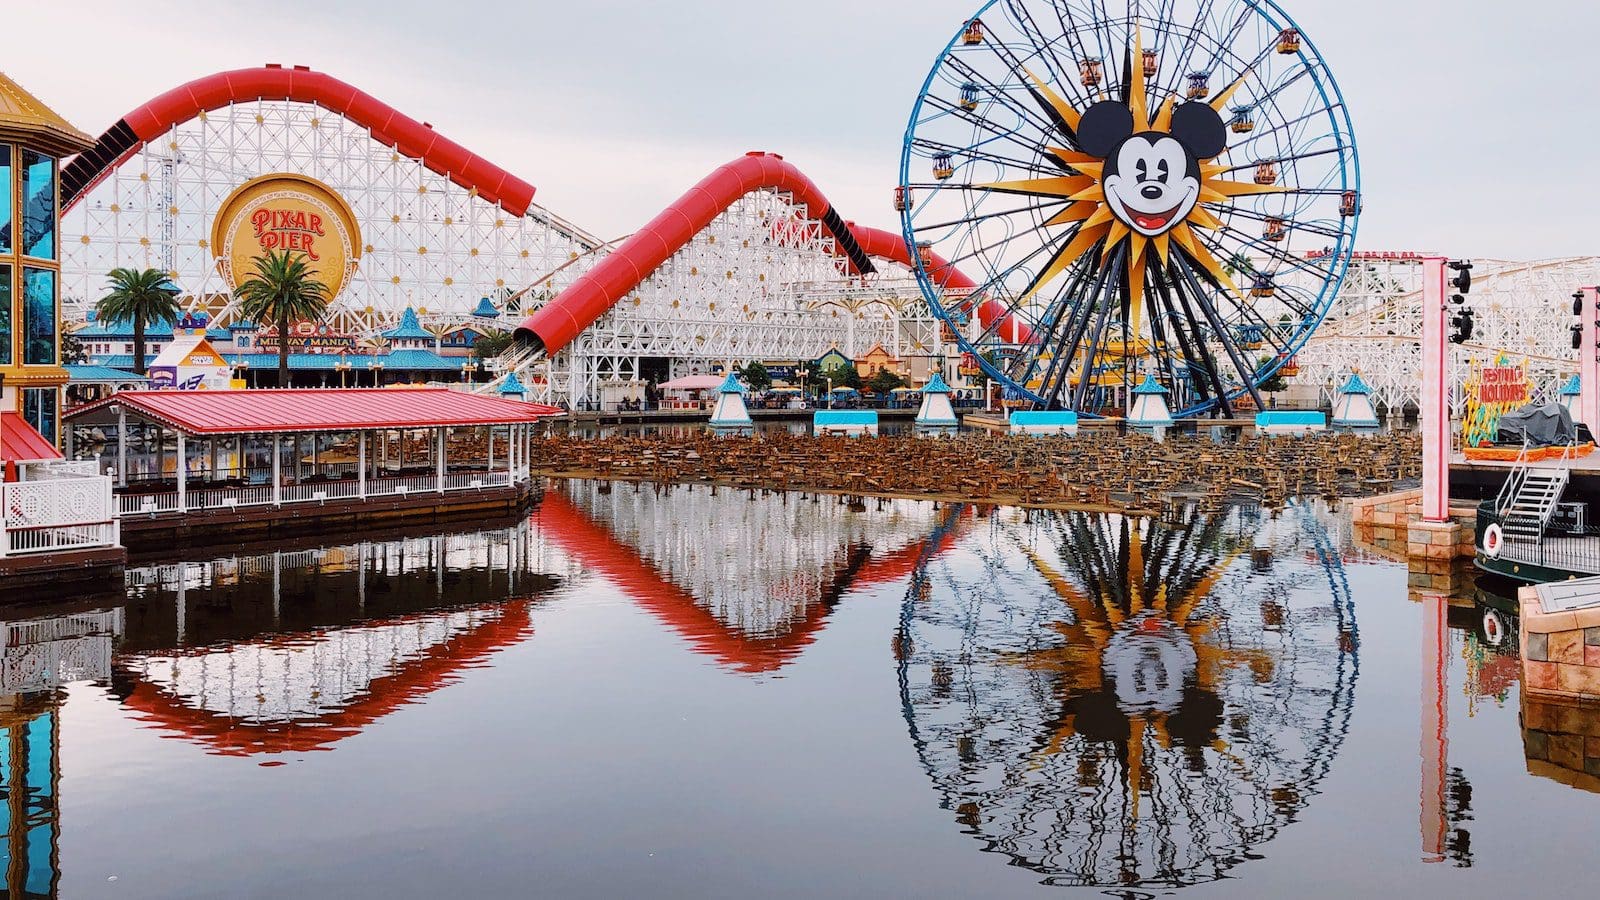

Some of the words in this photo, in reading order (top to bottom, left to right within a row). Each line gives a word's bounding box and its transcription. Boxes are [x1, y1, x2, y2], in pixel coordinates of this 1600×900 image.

[251, 208, 325, 237] PIXAR
[260, 231, 320, 261] PIER
[311, 338, 353, 346] MANIA!
